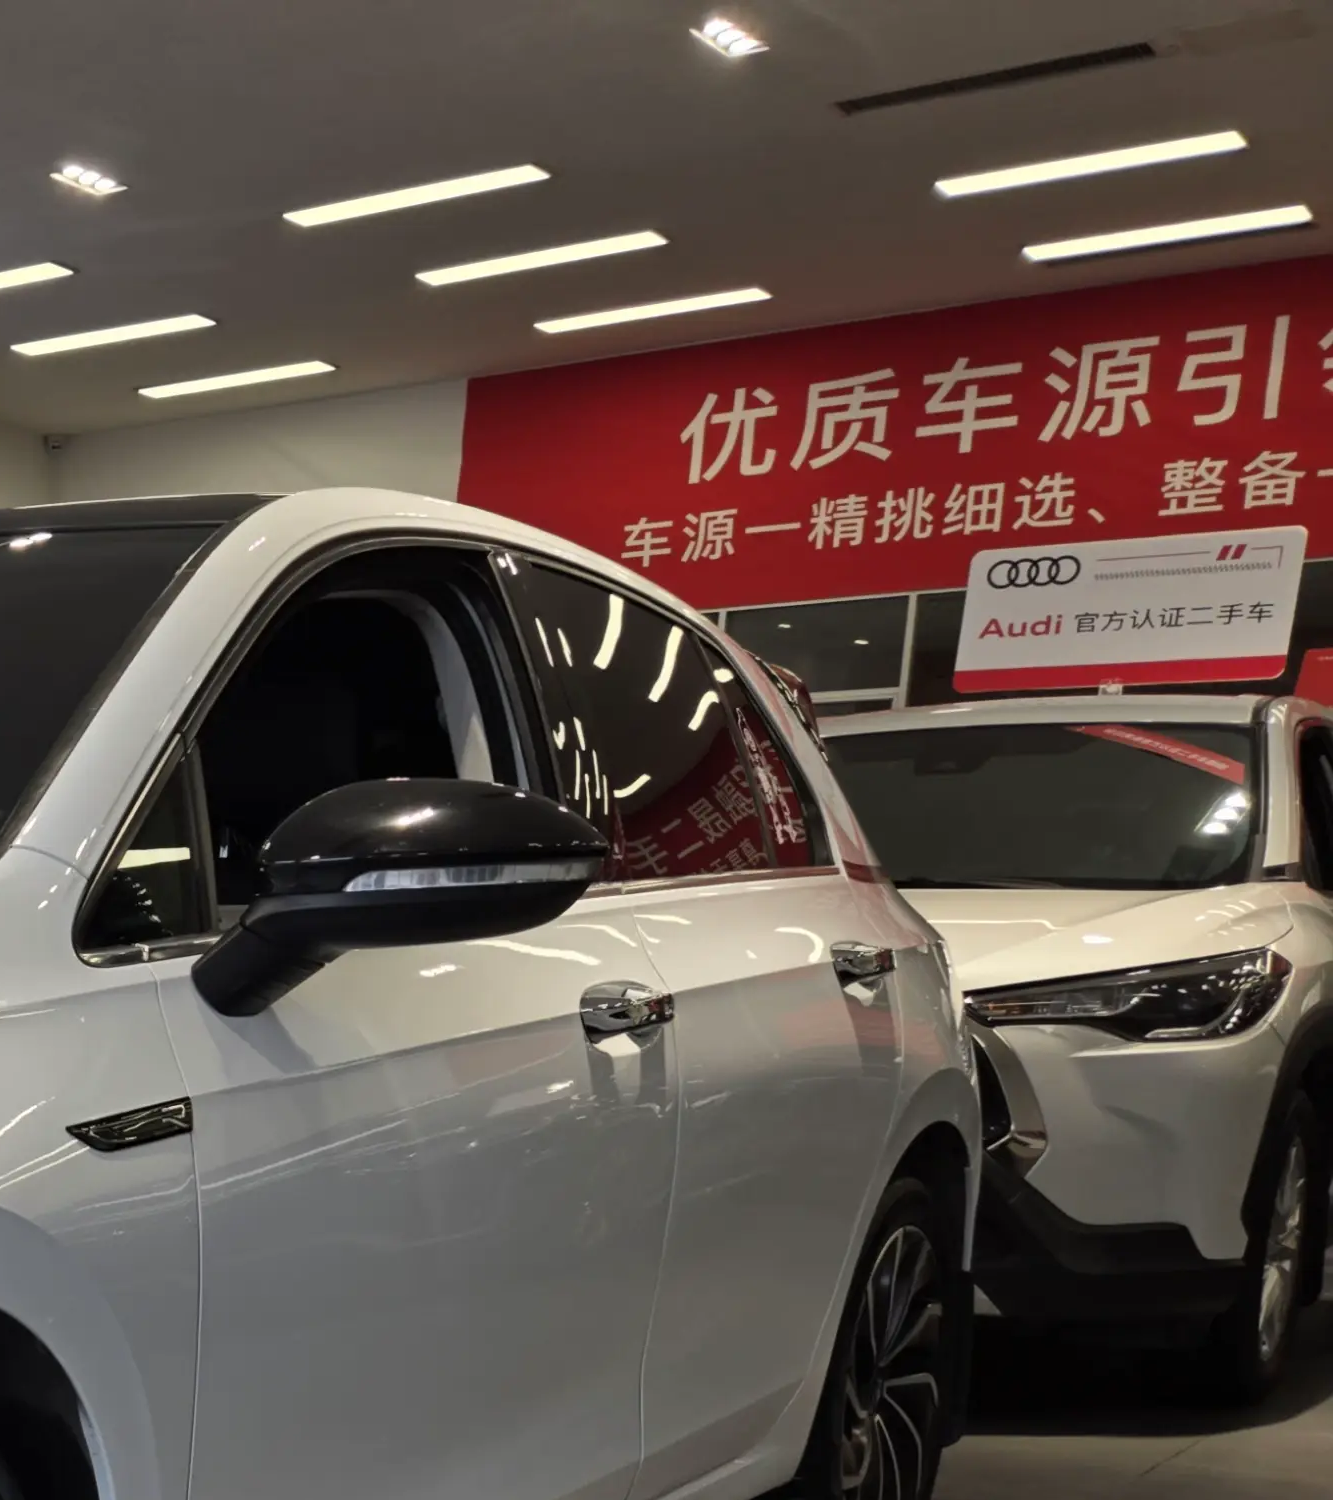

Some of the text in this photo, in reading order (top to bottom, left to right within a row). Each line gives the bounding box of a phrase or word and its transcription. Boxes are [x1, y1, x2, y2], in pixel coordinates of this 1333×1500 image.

[621, 451, 1333, 568] 车源一精挑细选、整备
[978, 601, 1275, 640] Audi 官方认证二手车
